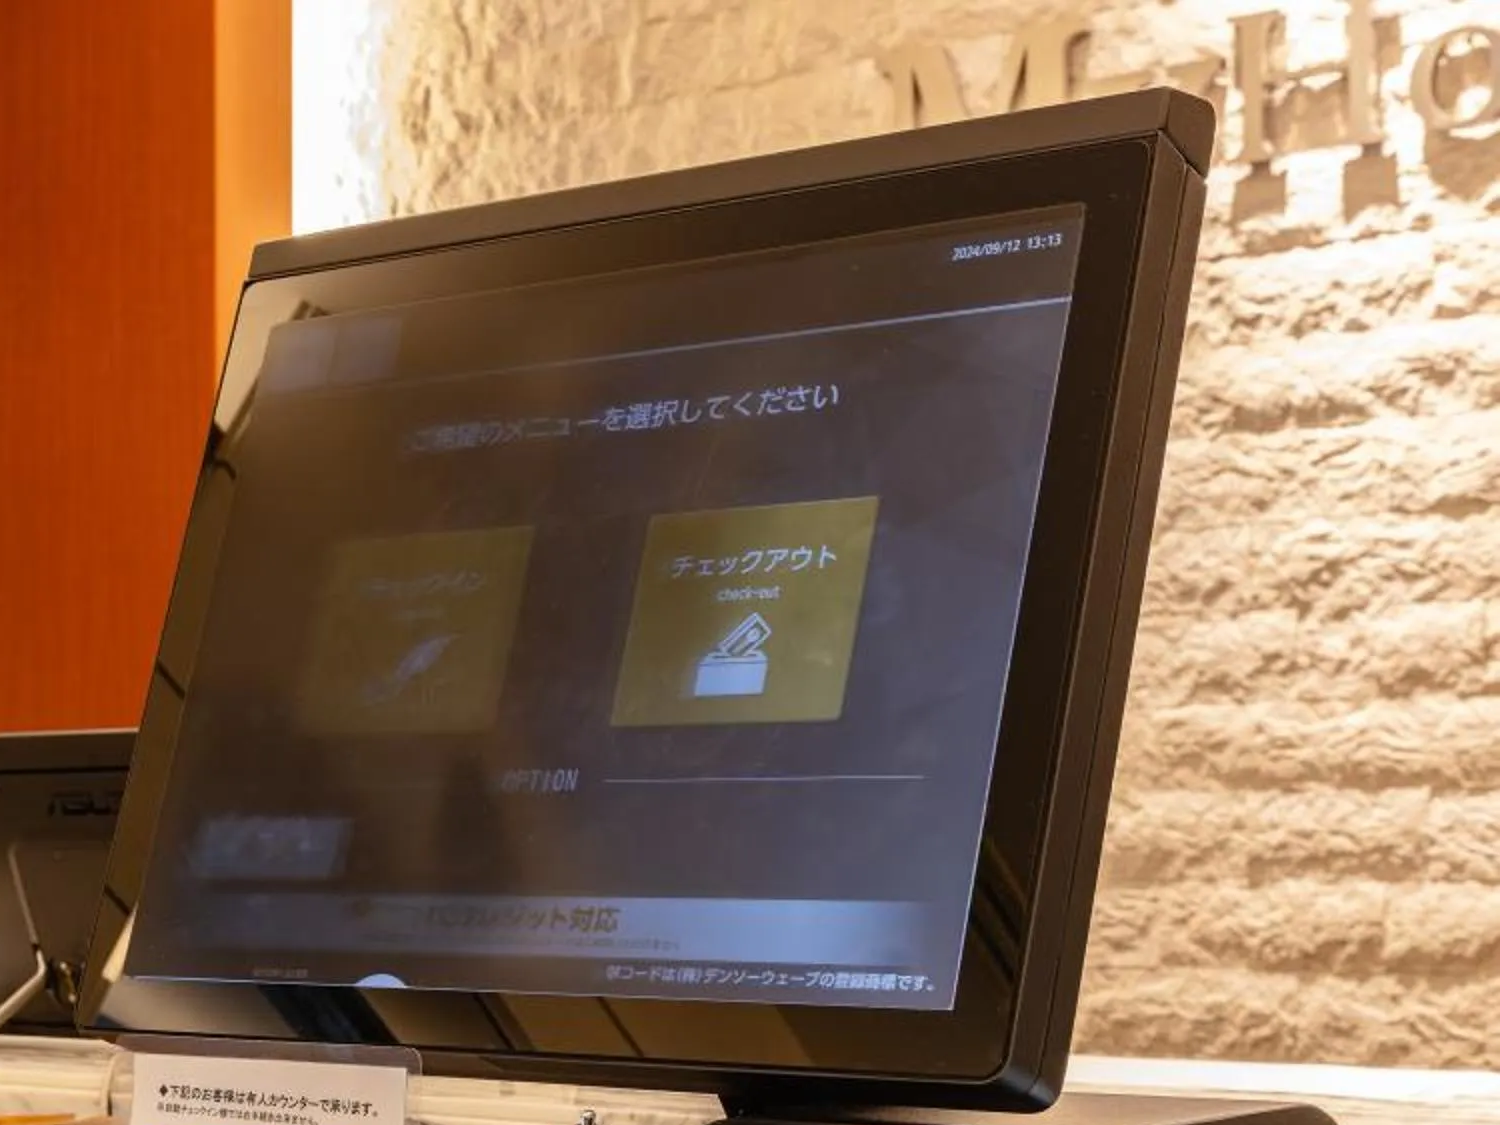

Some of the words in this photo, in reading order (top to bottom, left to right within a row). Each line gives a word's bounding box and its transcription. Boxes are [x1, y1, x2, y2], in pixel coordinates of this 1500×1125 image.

[951, 239, 1021, 261] 2024/09/12
[1027, 232, 1063, 251] 13:13
[411, 384, 841, 453] ご希望のメニューを選択してください
[672, 544, 837, 580] チェックアウト
[501, 768, 579, 795] OPTION
